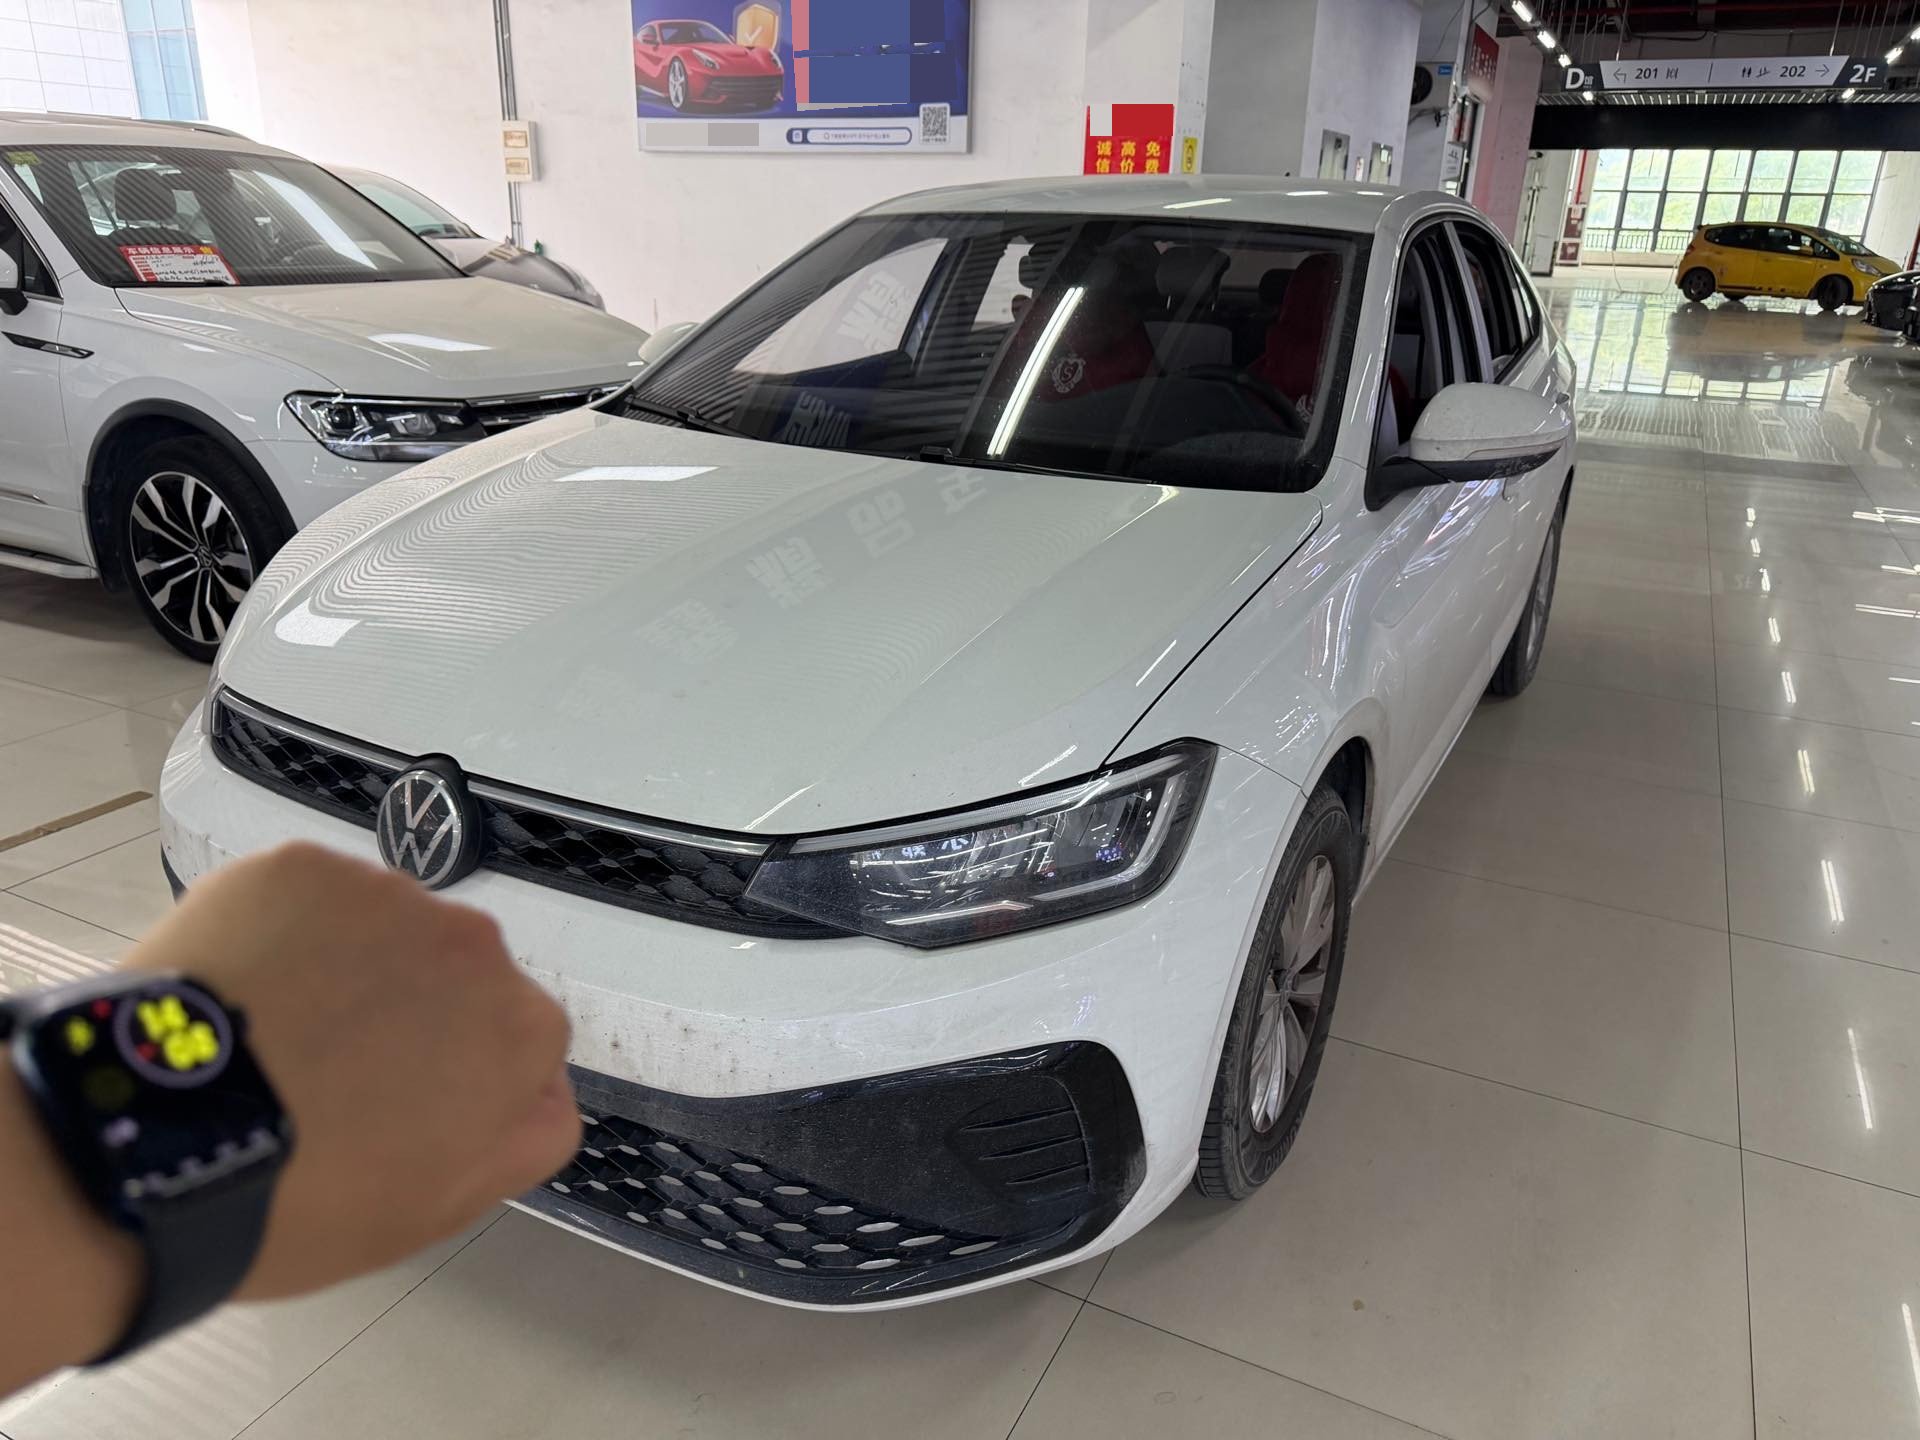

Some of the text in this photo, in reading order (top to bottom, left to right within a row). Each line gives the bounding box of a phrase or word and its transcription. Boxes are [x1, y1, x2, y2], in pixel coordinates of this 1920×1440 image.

[1634, 67, 1658, 80] 201
[1779, 65, 1806, 78] 202
[1849, 64, 1877, 83] 2F
[1120, 140, 1136, 173] 高价
